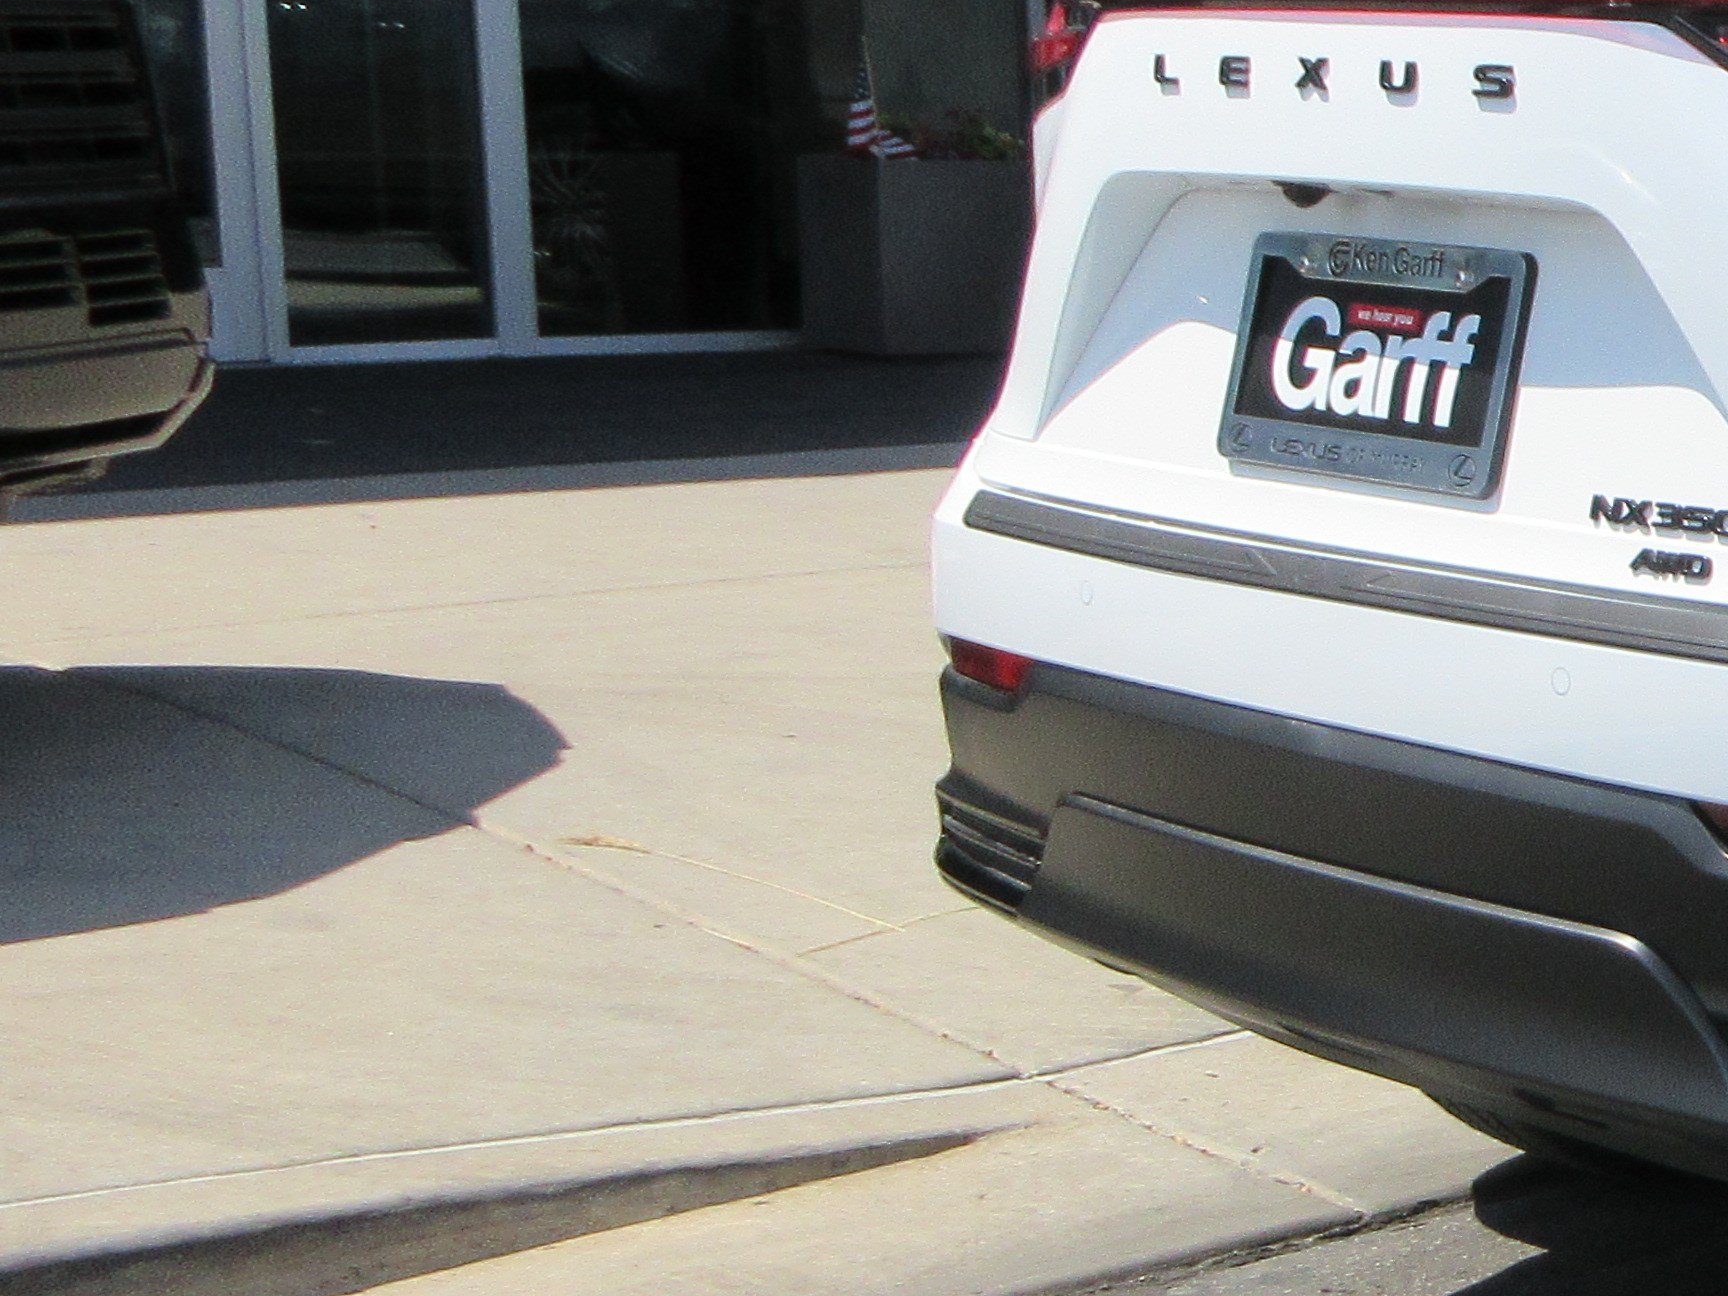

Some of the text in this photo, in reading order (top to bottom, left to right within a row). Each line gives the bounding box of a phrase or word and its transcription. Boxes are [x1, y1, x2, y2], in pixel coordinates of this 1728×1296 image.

[1153, 53, 1515, 100] LEXUS
[1351, 243, 1445, 278] Ken Garff
[1271, 295, 1481, 429] Garff
[1629, 548, 1714, 580] AWD
